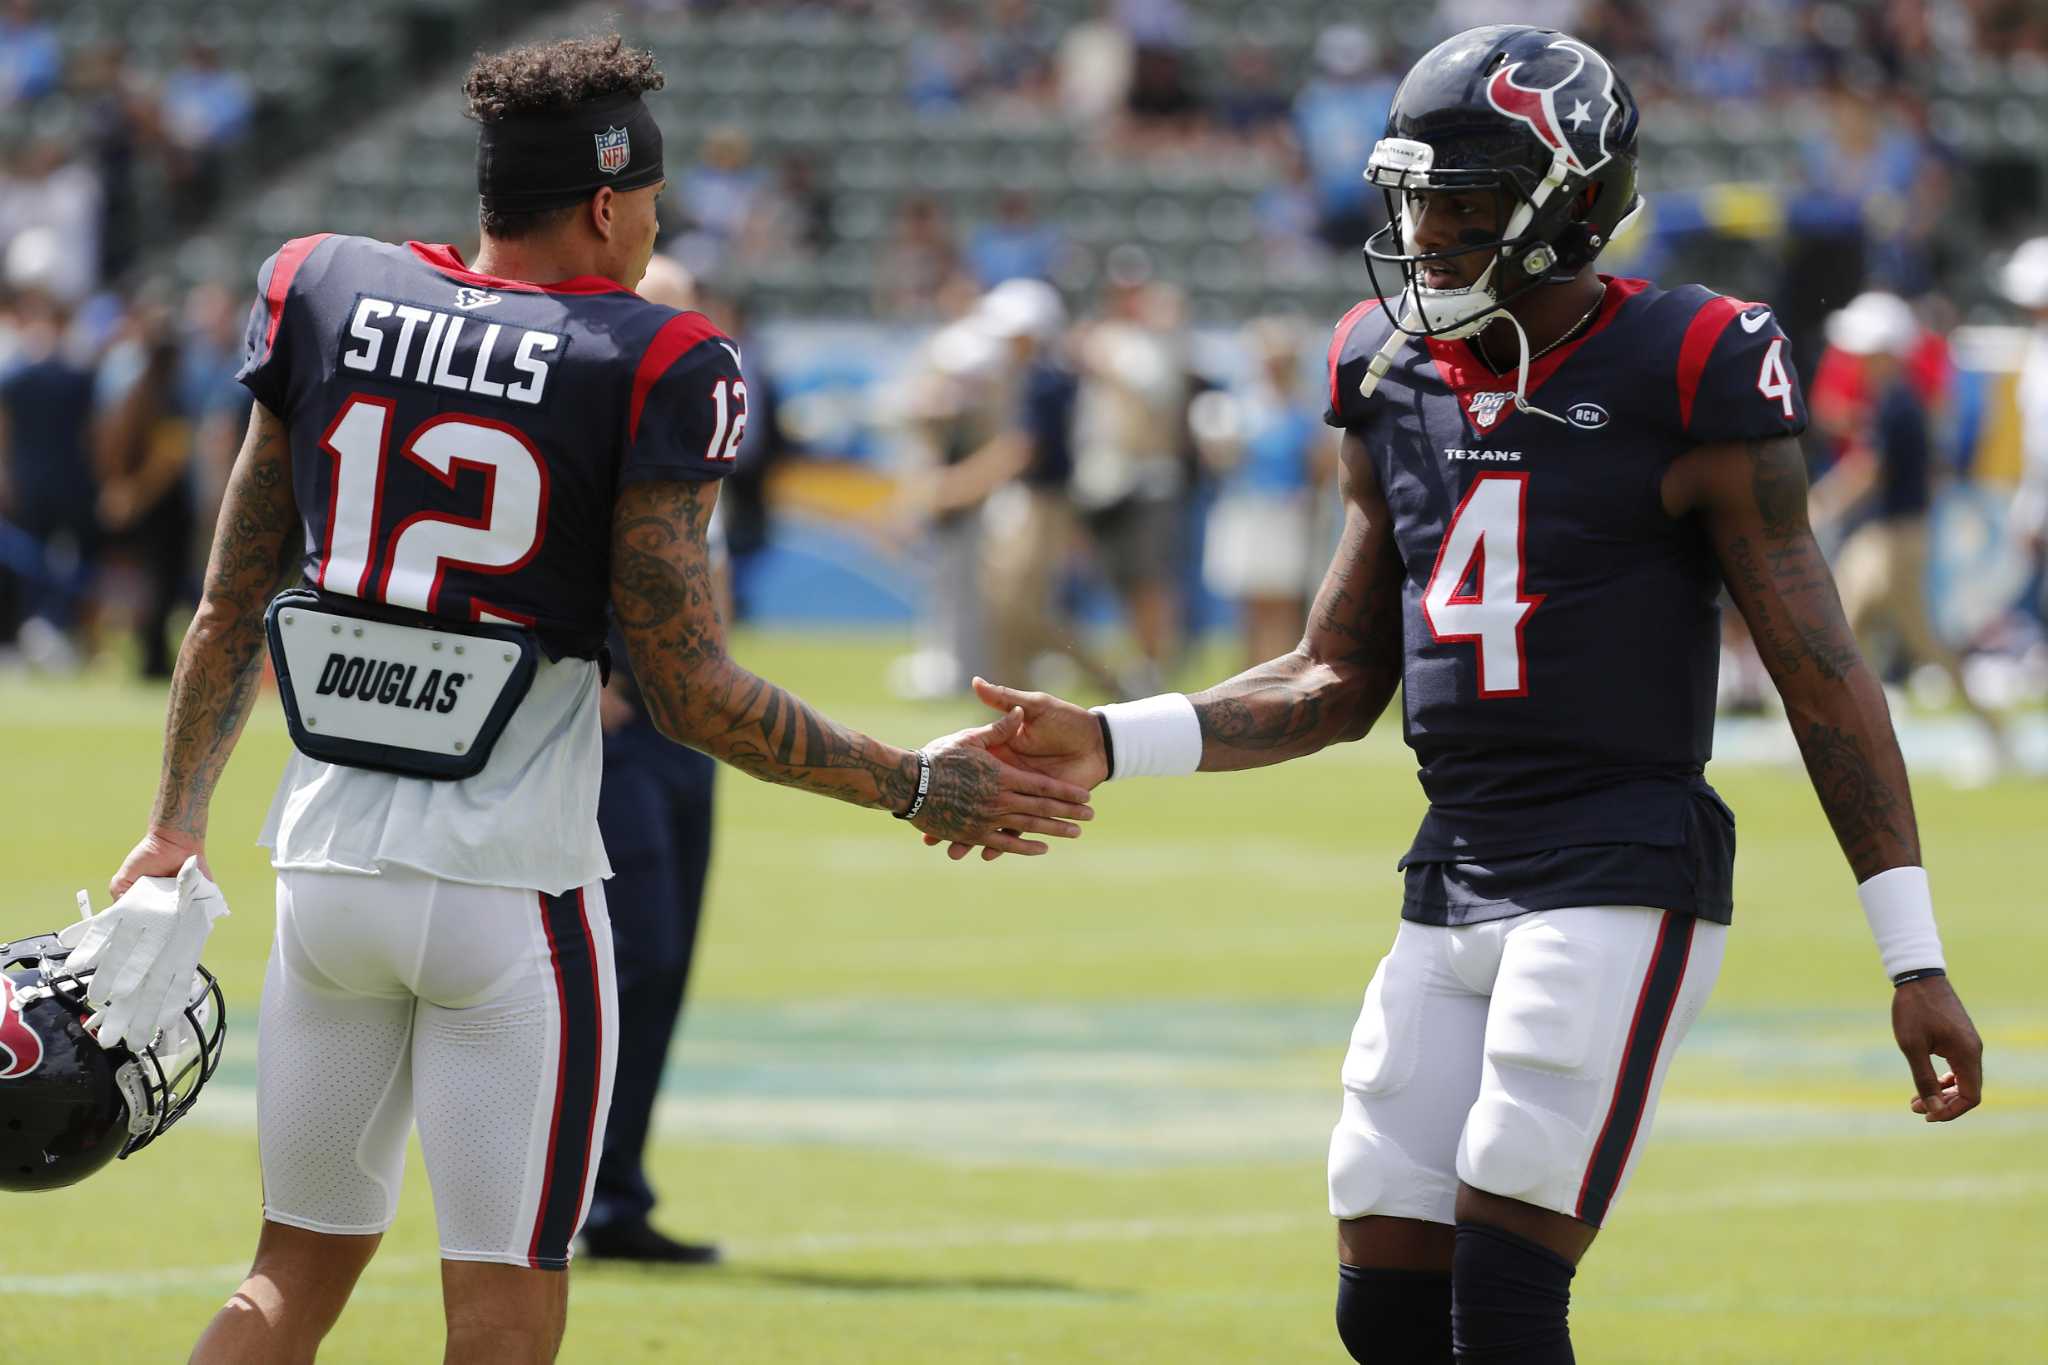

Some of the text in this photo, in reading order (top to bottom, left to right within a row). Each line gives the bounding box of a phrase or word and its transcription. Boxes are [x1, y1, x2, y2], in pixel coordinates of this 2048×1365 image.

[603, 146, 625, 167] NFL
[344, 298, 558, 404] STILLS
[1756, 335, 1793, 420] 4
[704, 376, 748, 462] 12
[1444, 449, 1522, 462] TEXANS
[317, 392, 549, 626] 12
[1421, 471, 1547, 699] 4
[315, 653, 466, 714] DOUGLAS
[919, 768, 929, 794] LIVES
